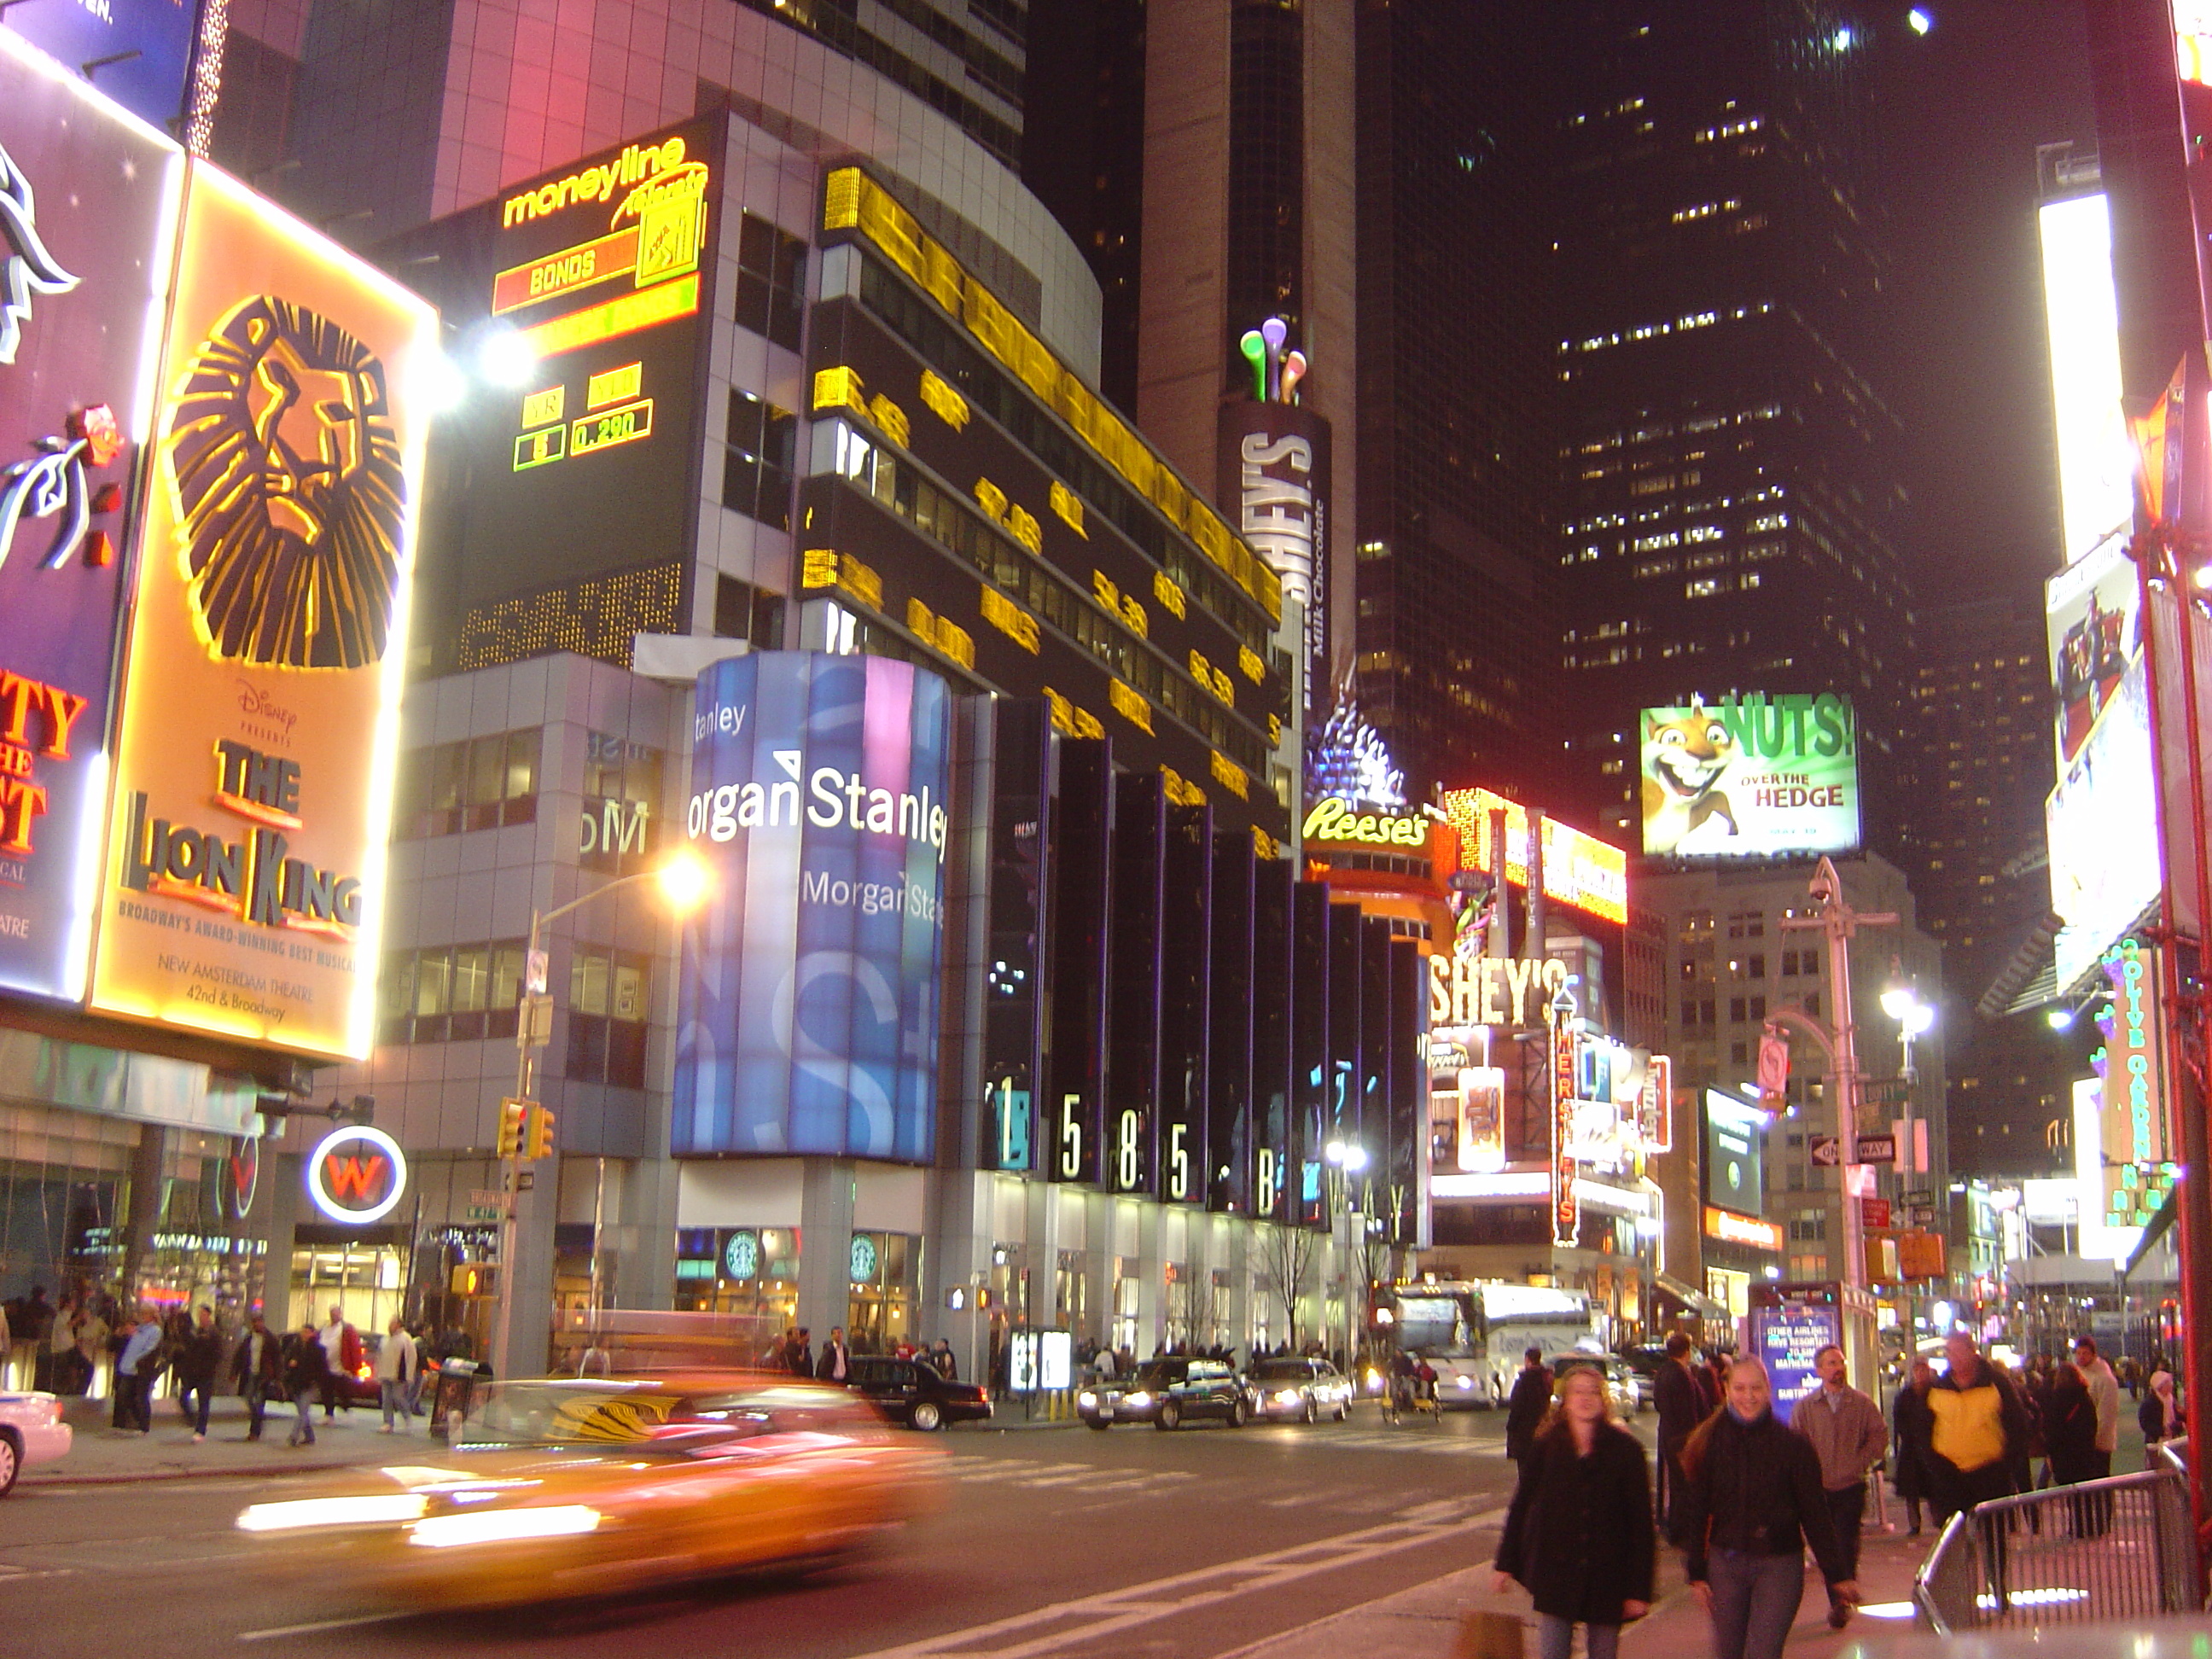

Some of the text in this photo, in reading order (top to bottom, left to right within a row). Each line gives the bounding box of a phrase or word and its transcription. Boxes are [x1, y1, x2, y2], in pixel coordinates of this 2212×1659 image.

[504, 137, 686, 229] moneyline
[529, 249, 597, 295] BONDS
[1313, 498, 1324, 658] Milk Chocolate
[236, 679, 298, 734] Disney
[1724, 693, 1854, 758] NUTS!
[212, 737, 301, 814] THE
[1741, 772, 1809, 787] OVER THE
[1755, 783, 1844, 808] HEDGE
[806, 767, 947, 864] Stanley
[1302, 796, 1429, 847] Reese's
[120, 789, 363, 927] LION KING
[802, 870, 910, 916] Morgan
[118, 900, 191, 933] BROADWAY'S
[195, 920, 285, 956] AWARD-WINNING
[288, 943, 314, 963] BEST
[157, 953, 314, 1003] NEW AMSTERDAM THEATRE
[186, 984, 286, 1023] 42nd & Broadway
[1861, 1143, 1885, 1156] WAY
[326, 1154, 384, 1201] W
[1767, 1325, 1829, 1336] OTHER AIRLINES
[1767, 1336, 1788, 1348] HAVE
